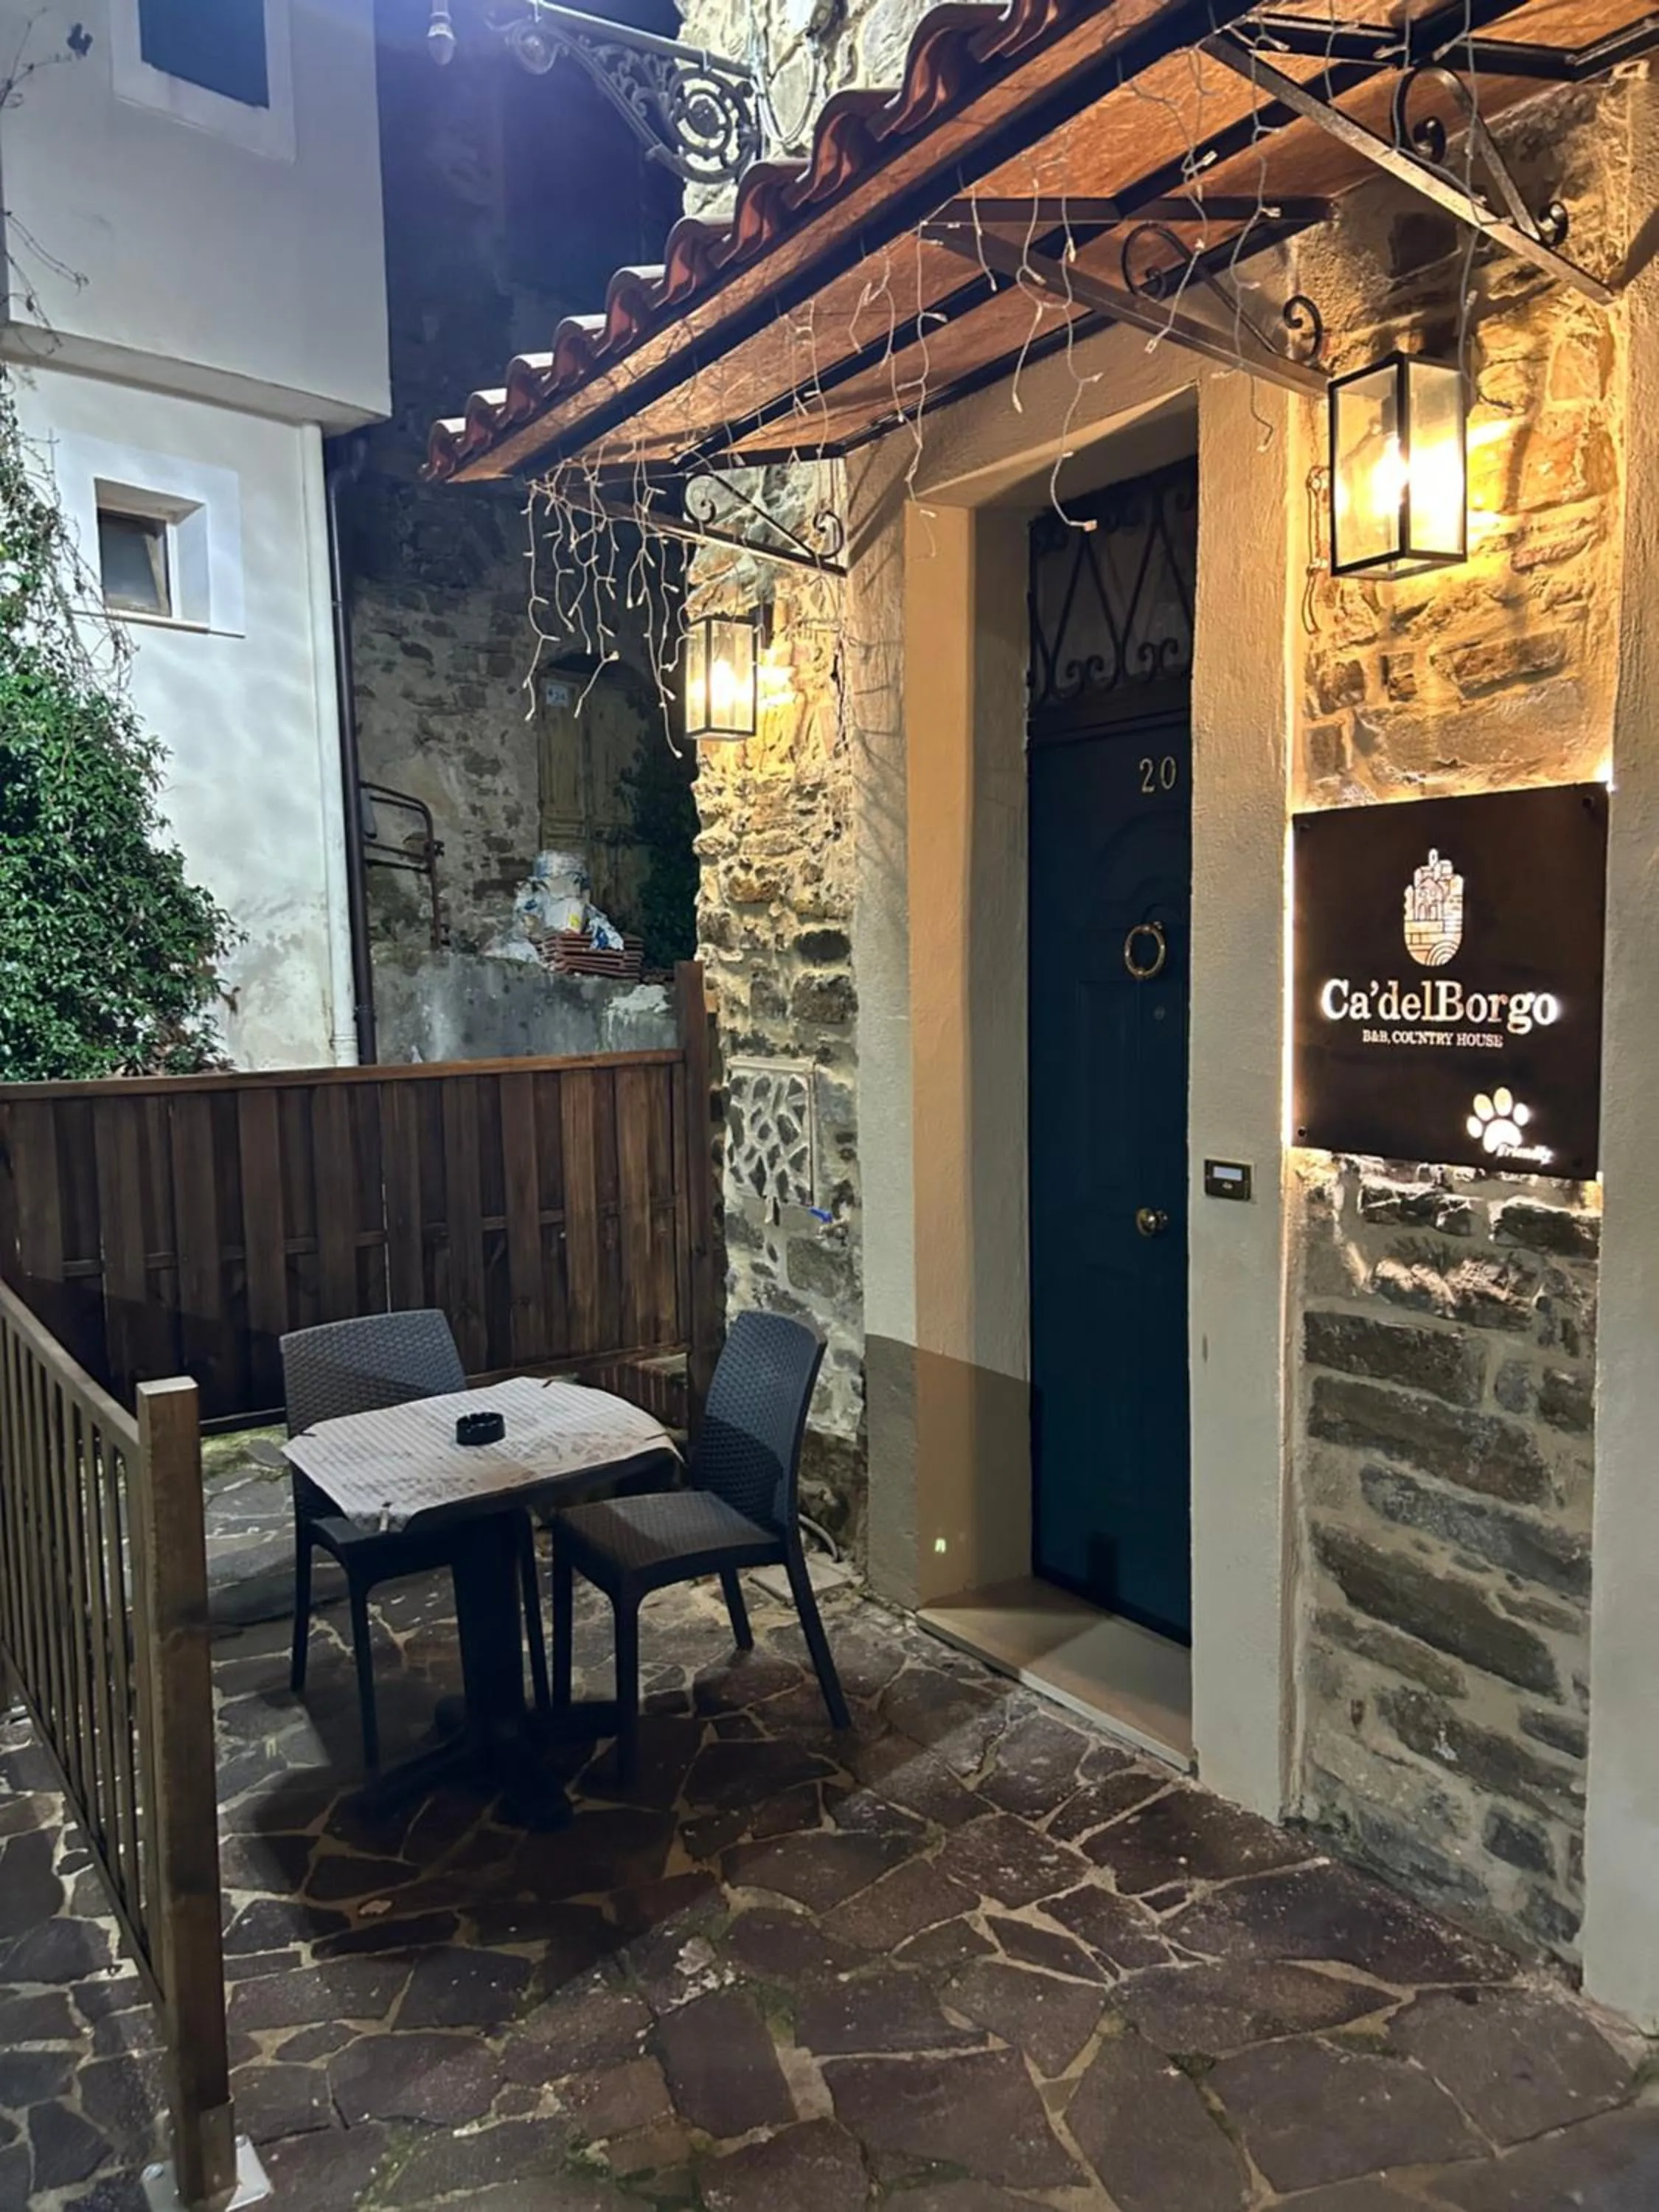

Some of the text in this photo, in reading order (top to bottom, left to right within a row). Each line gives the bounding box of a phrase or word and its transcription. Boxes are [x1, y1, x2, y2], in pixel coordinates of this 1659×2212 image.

[1139, 756, 1177, 793] 20
[1321, 978, 1560, 1034] Ca'delBorgo
[1391, 1030, 1454, 1046] COUNTRY
[1455, 1033, 1504, 1048] HOUSE
